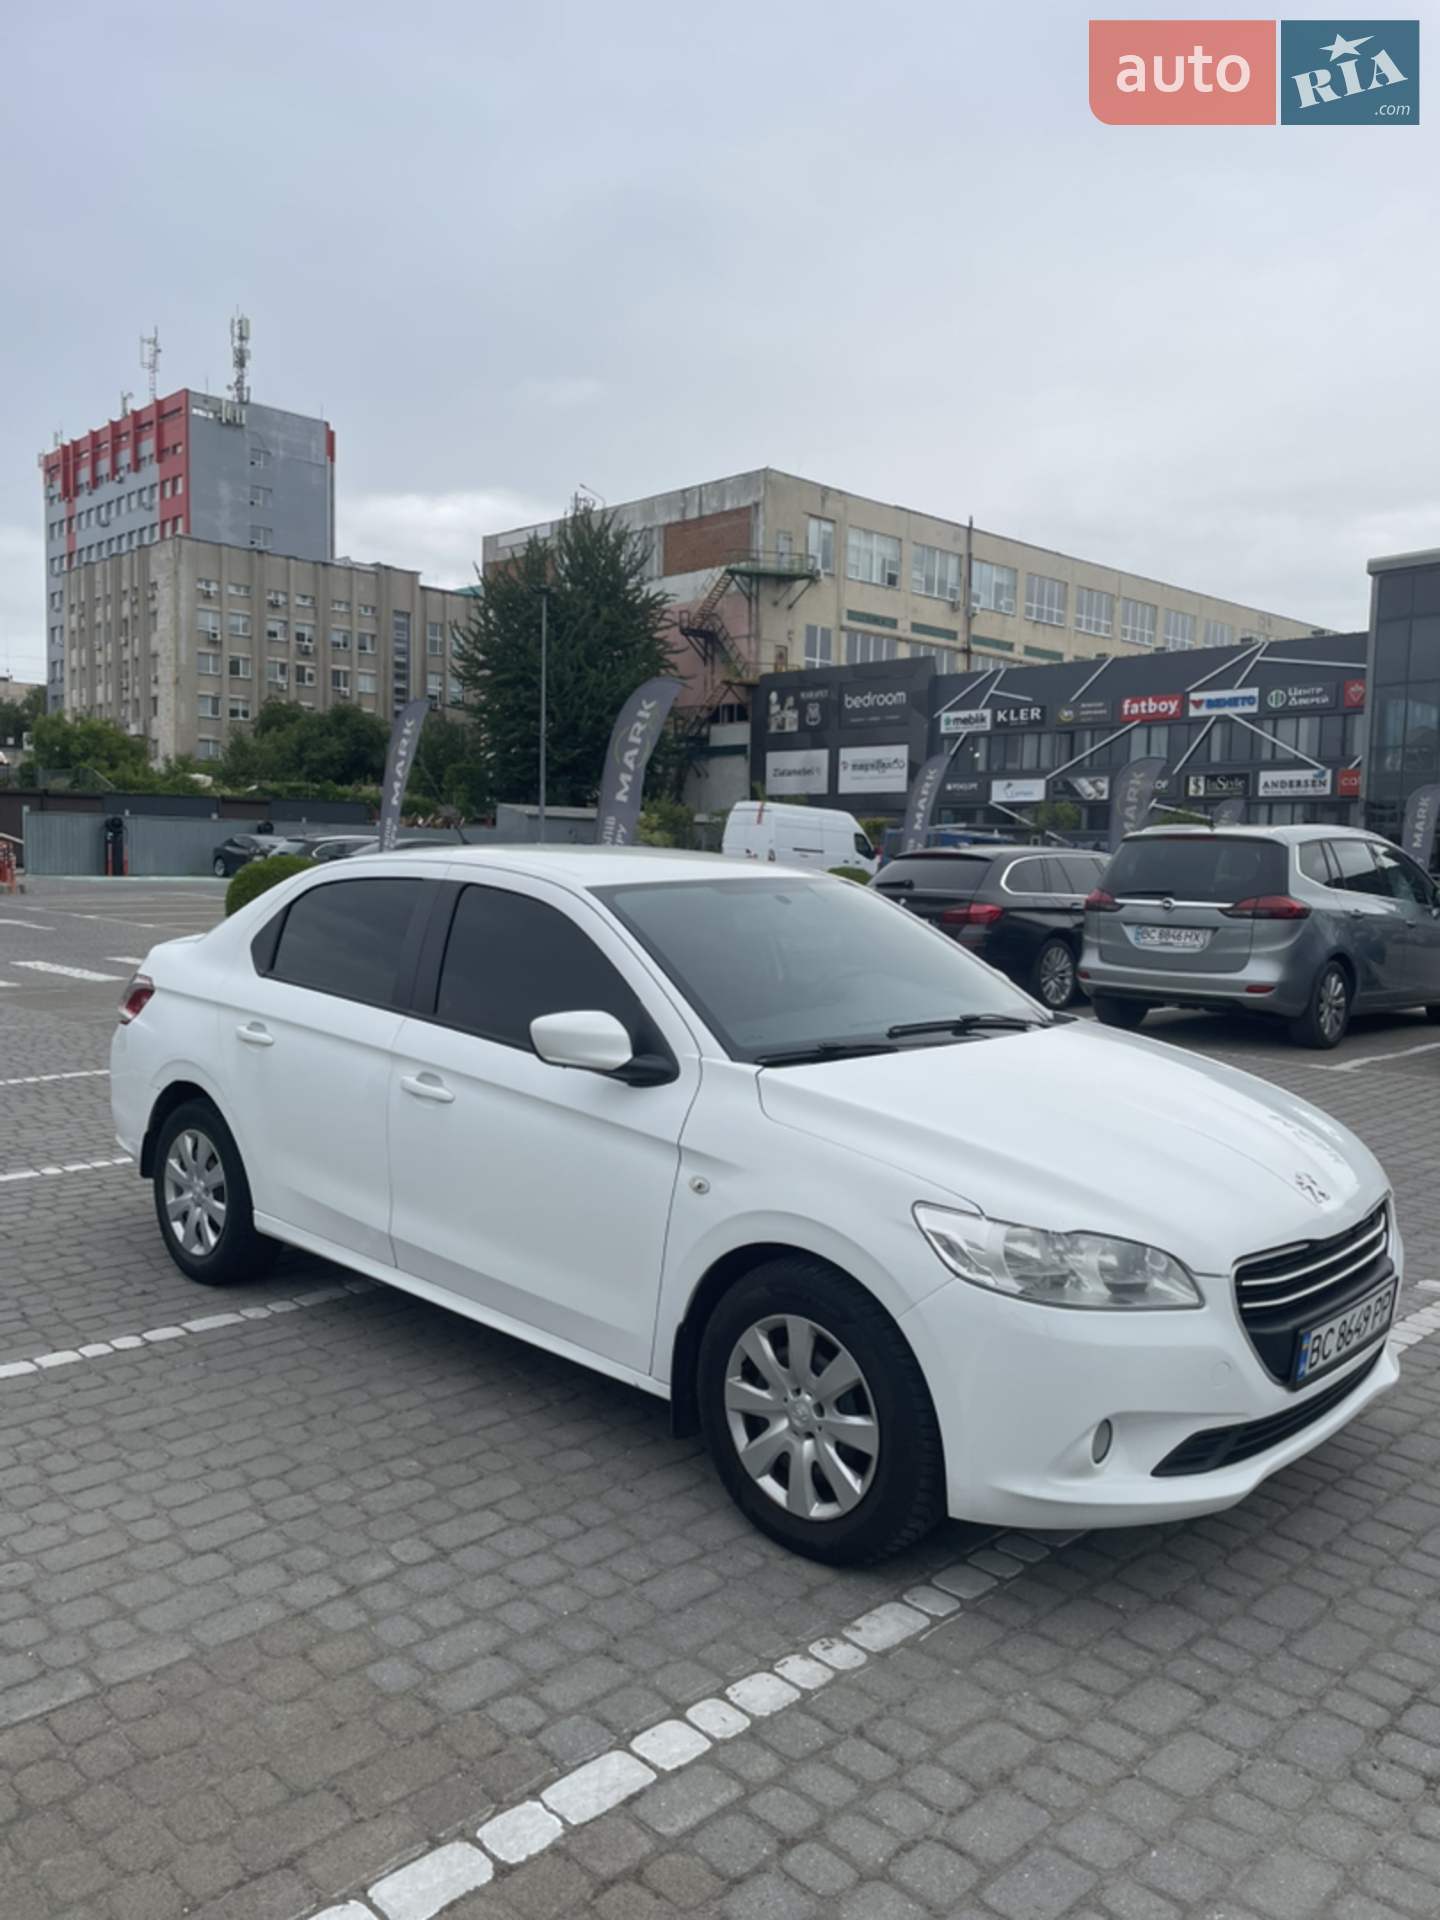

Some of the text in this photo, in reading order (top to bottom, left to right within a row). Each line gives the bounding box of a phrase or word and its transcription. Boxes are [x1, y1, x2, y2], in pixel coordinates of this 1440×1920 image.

[844, 691, 906, 709] bedroom
[1123, 698, 1179, 715] fatboy
[953, 713, 988, 726] meblik
[996, 707, 1041, 722] KLER
[615, 699, 656, 803] MARK
[391, 719, 415, 805] MARK
[1206, 776, 1245, 790] InStyle
[1262, 779, 1327, 789] ANDERSEN
[913, 768, 937, 830] MARK
[1412, 796, 1430, 848] MARK
[1141, 929, 1157, 940] BC
[1183, 930, 1201, 942] HX
[1309, 1290, 1391, 1370] BC 8649 PP
